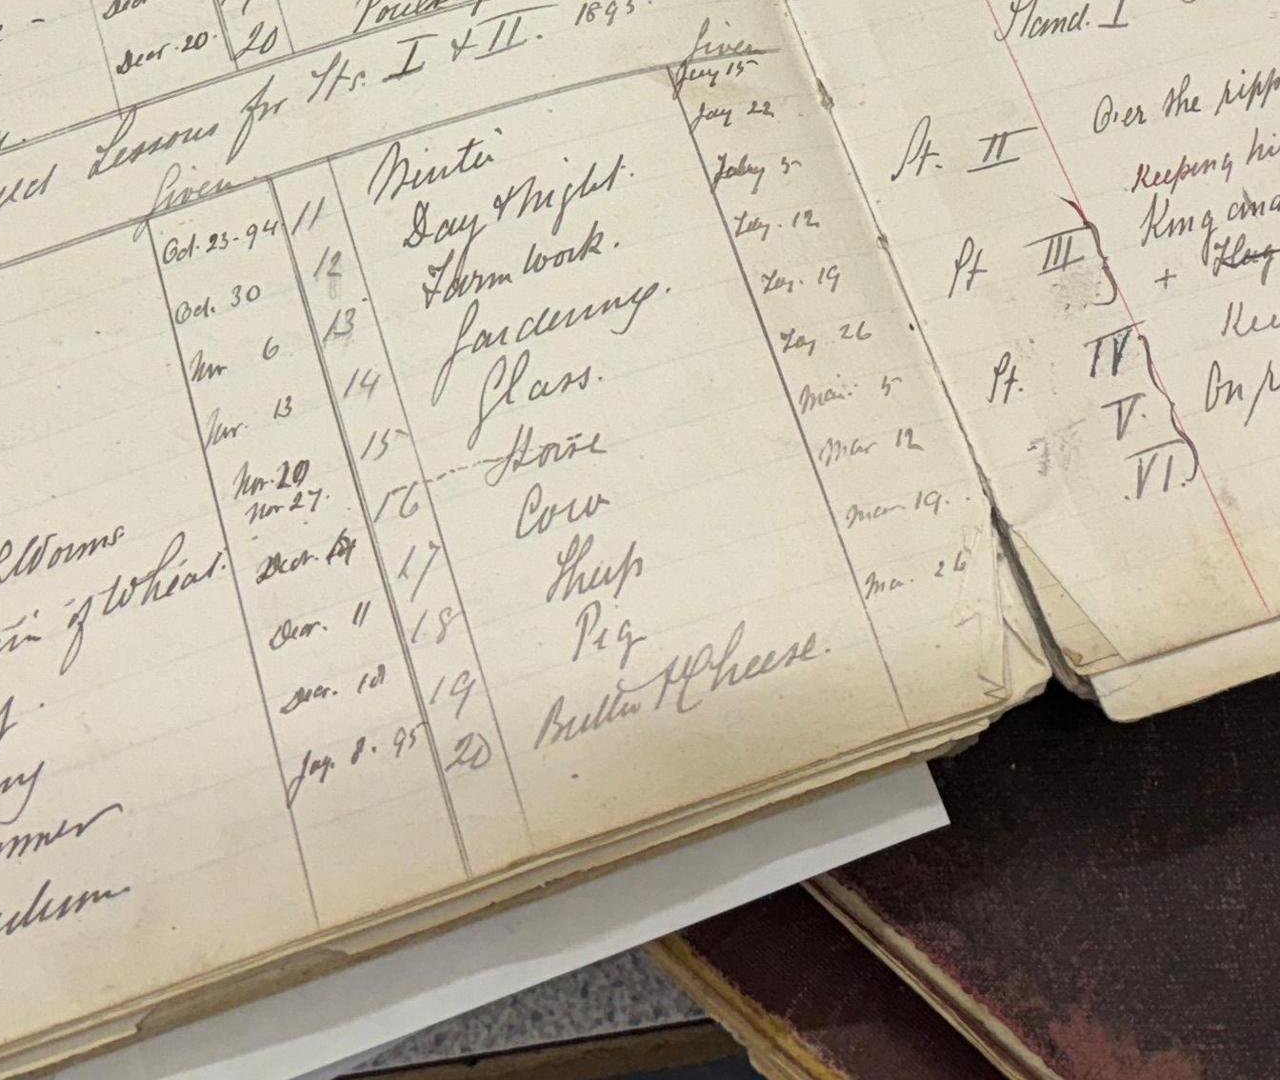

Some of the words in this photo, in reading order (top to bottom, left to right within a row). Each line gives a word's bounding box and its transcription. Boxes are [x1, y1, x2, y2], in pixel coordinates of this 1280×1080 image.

[234, 25, 280, 61] 20
[1161, 73, 1203, 117] the
[86, 104, 221, 181] Lessons
[224, 74, 289, 166] for
[1130, 151, 1235, 195] Keeping
[291, 196, 326, 237] 11
[312, 245, 344, 280] 12
[402, 200, 488, 304] Day
[230, 283, 262, 309] 30
[817, 264, 842, 292] 19
[321, 306, 358, 343] 13
[839, 321, 873, 341] 26
[261, 336, 282, 363] 6
[342, 367, 382, 401] 14
[273, 394, 294, 421] 13
[359, 428, 410, 462] 15
[466, 350, 591, 451] Glass
[894, 426, 924, 452] 12
[396, 539, 441, 604] 17
[515, 481, 612, 541] Cow
[351, 600, 373, 627] 11
[59, 599, 95, 677] of
[428, 670, 477, 722] 19
[570, 599, 647, 671] Pig
[444, 731, 493, 773] 20
